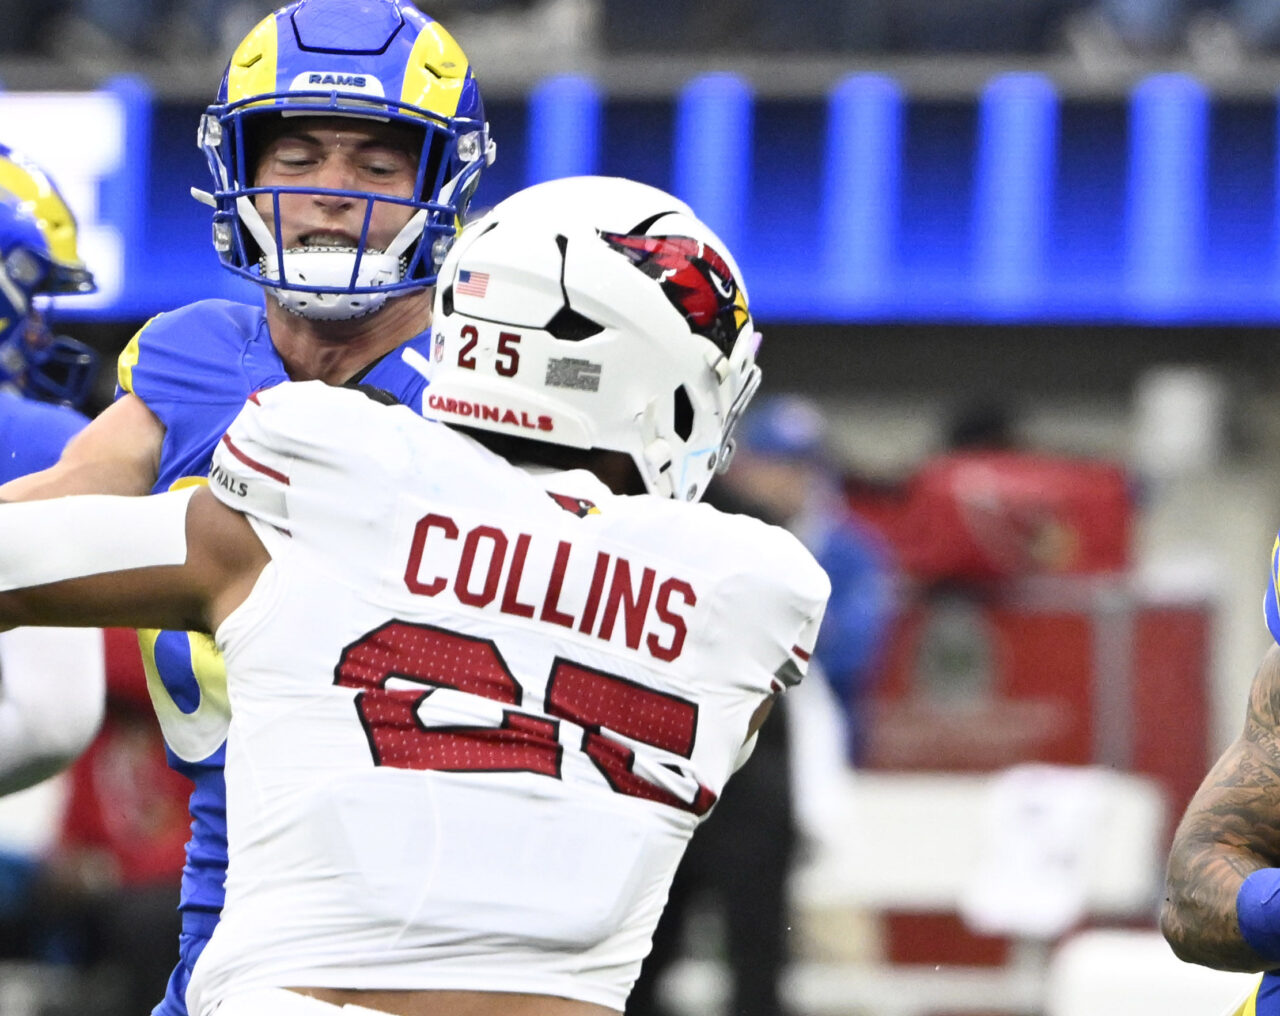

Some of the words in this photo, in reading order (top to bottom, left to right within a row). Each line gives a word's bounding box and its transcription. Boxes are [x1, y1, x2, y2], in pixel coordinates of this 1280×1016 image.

[308, 74, 366, 87] RAMS
[428, 394, 554, 432] CARDINALS
[404, 513, 697, 663] COLLINS
[333, 617, 718, 817] 25
